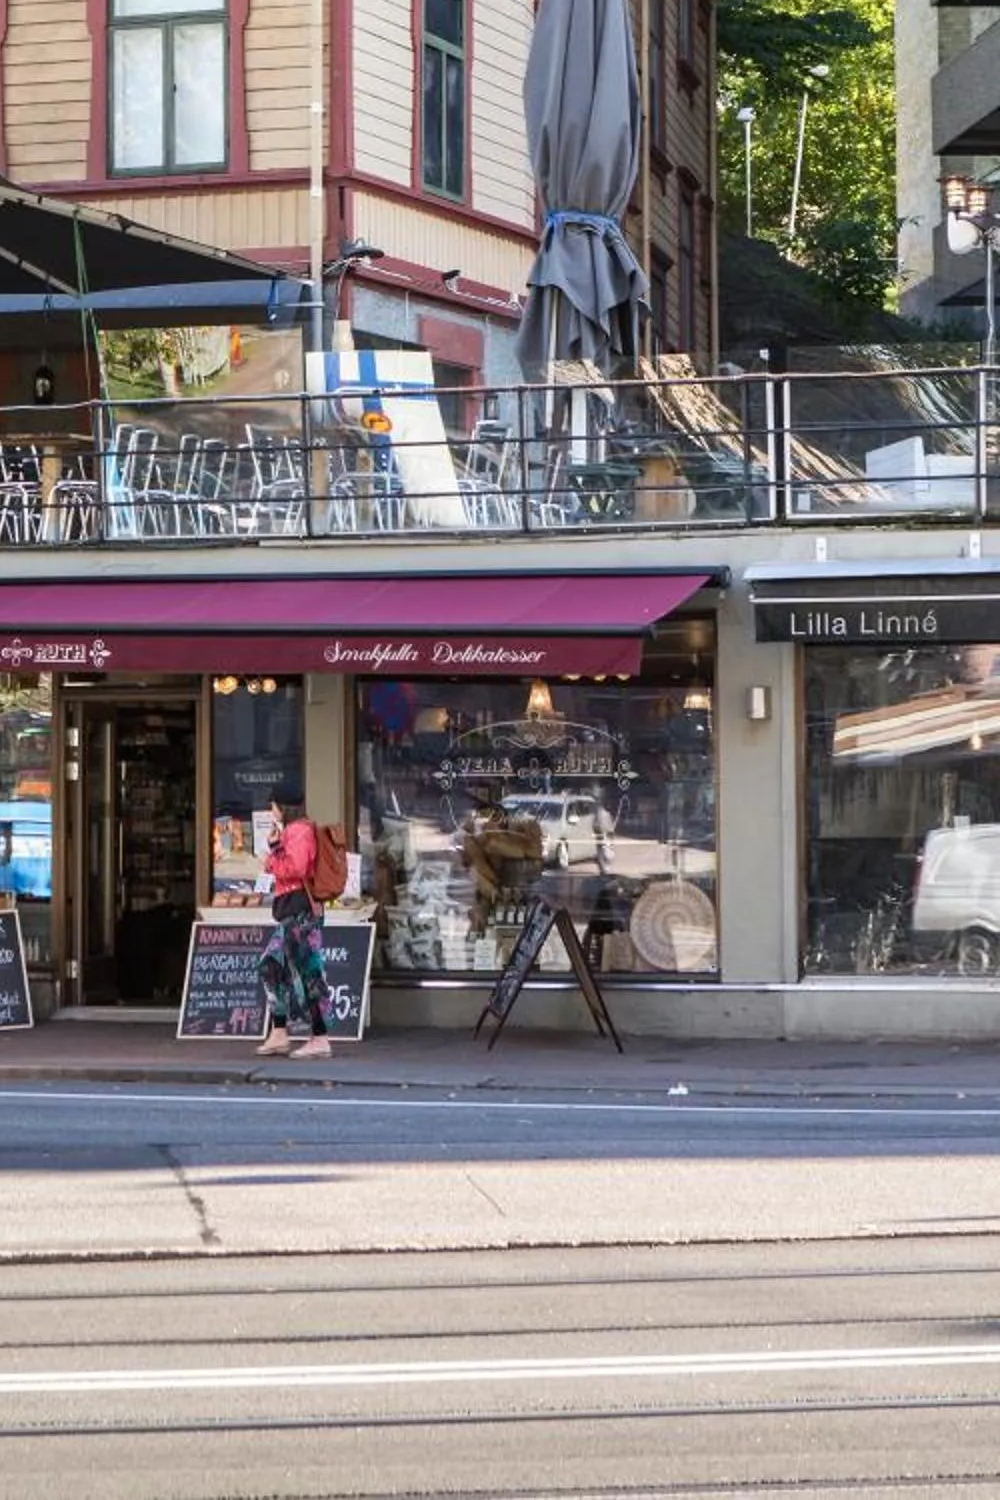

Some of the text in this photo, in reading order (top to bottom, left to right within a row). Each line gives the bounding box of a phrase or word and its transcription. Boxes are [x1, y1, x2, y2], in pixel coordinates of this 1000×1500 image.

[790, 609, 938, 636] Lilla Linné
[323, 641, 547, 671] Smakfulla Delikatesser
